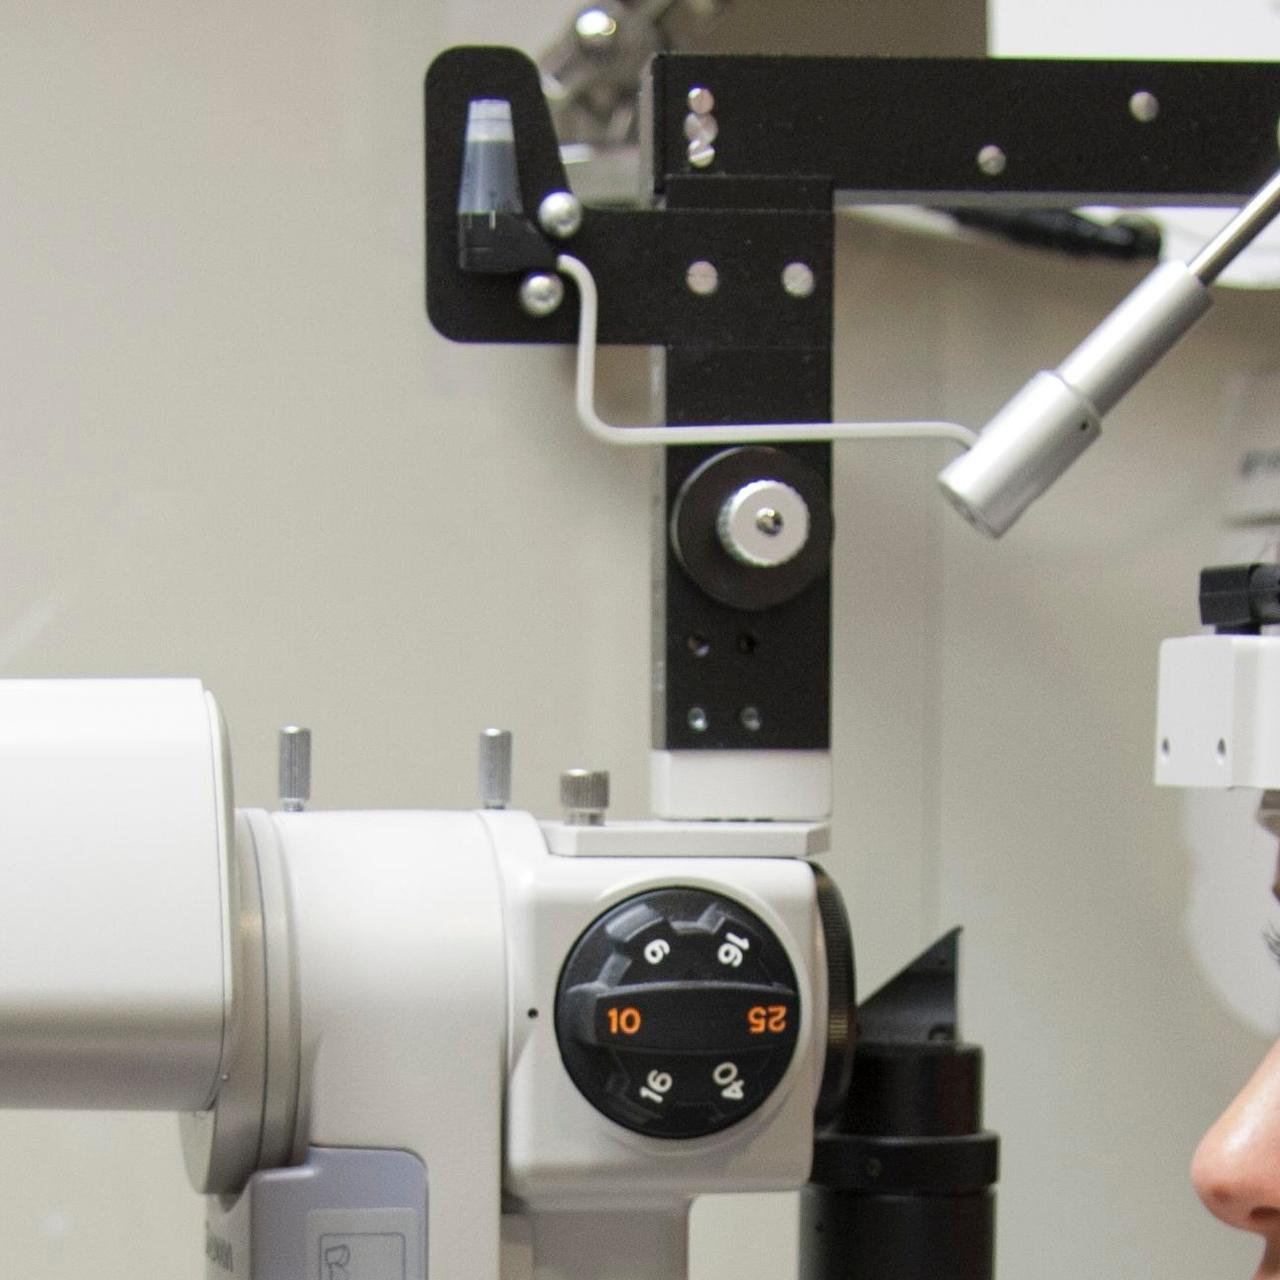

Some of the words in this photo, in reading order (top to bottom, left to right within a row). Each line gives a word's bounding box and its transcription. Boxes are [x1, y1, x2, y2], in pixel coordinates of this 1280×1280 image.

[643, 938, 671, 965] 6
[717, 932, 751, 967] 16
[607, 1007, 641, 1034] 10
[747, 1005, 787, 1034] 25
[639, 1069, 673, 1104] 16
[712, 1061, 746, 1102] 40
